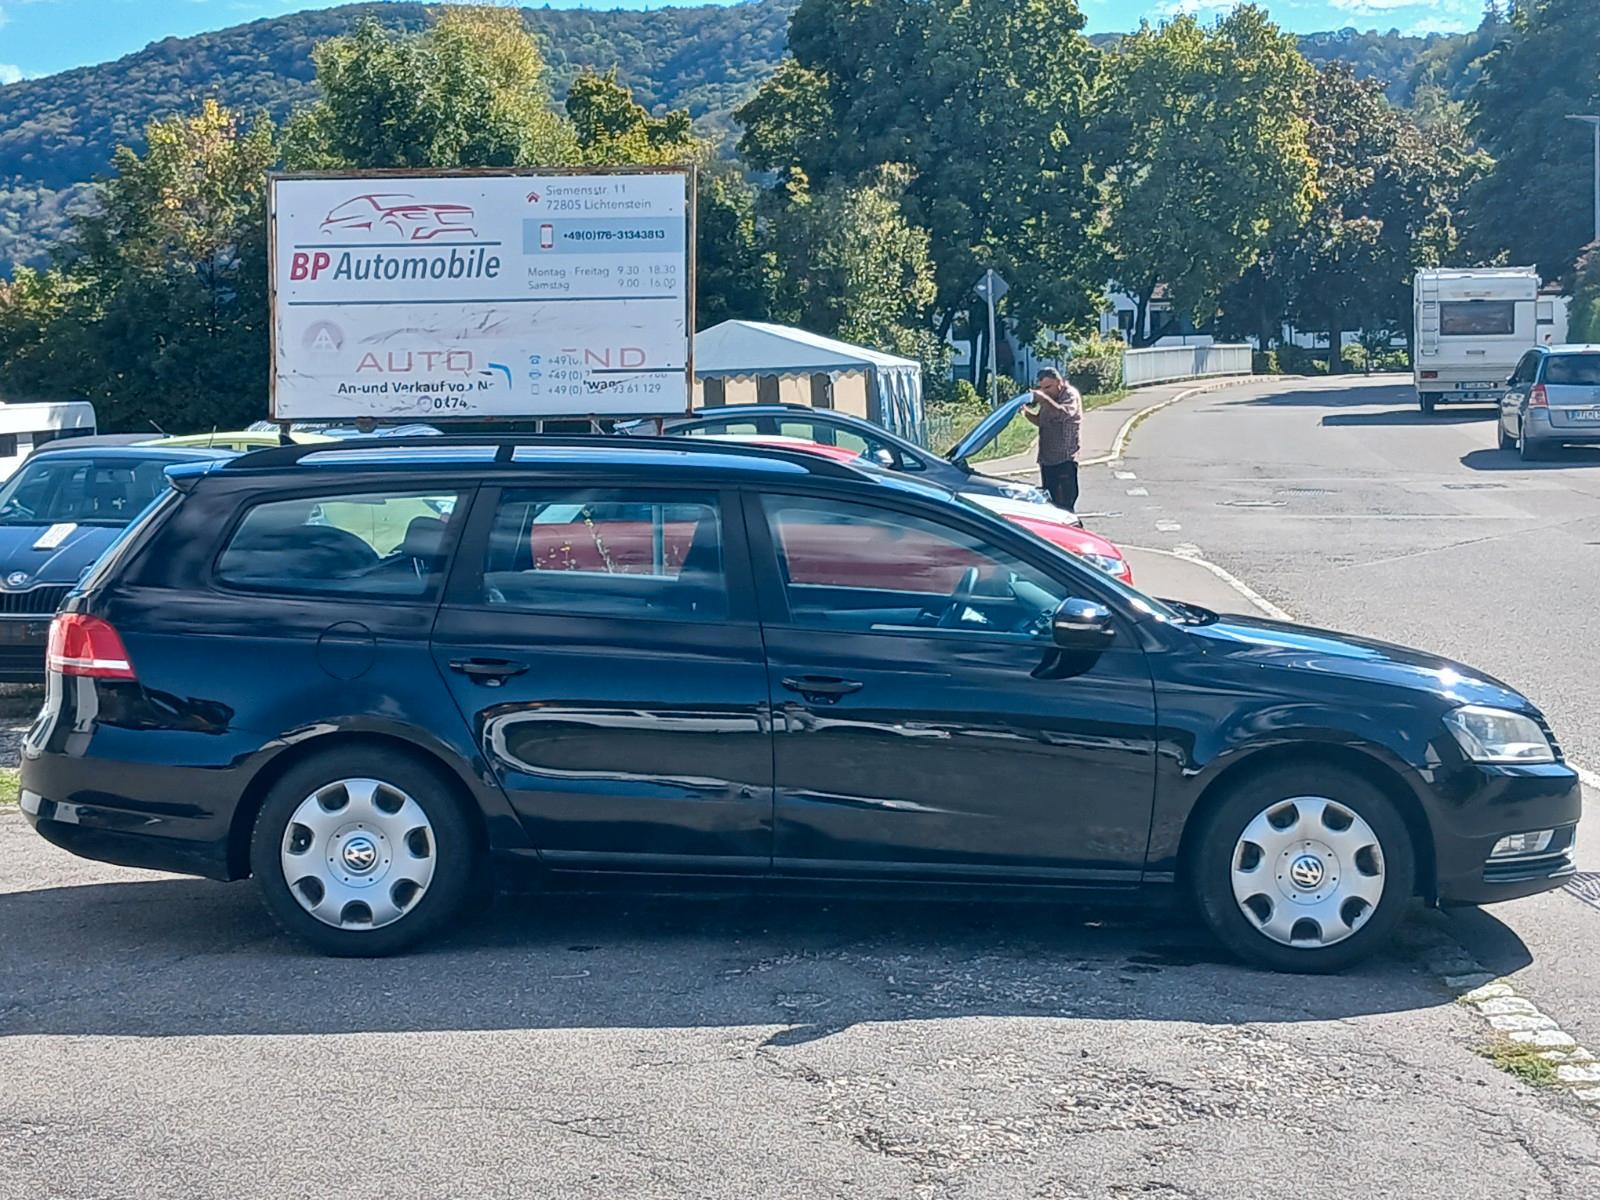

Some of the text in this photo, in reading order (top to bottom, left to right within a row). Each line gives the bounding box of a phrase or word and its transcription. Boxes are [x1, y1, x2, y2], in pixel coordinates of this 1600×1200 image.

[613, 184, 626, 193] 11
[546, 198, 651, 210] 72805 Lichtenstein
[290, 248, 500, 280] BP Automobile
[527, 267, 566, 278] Montag
[574, 265, 610, 277] Freitag
[527, 281, 570, 291] Samstag
